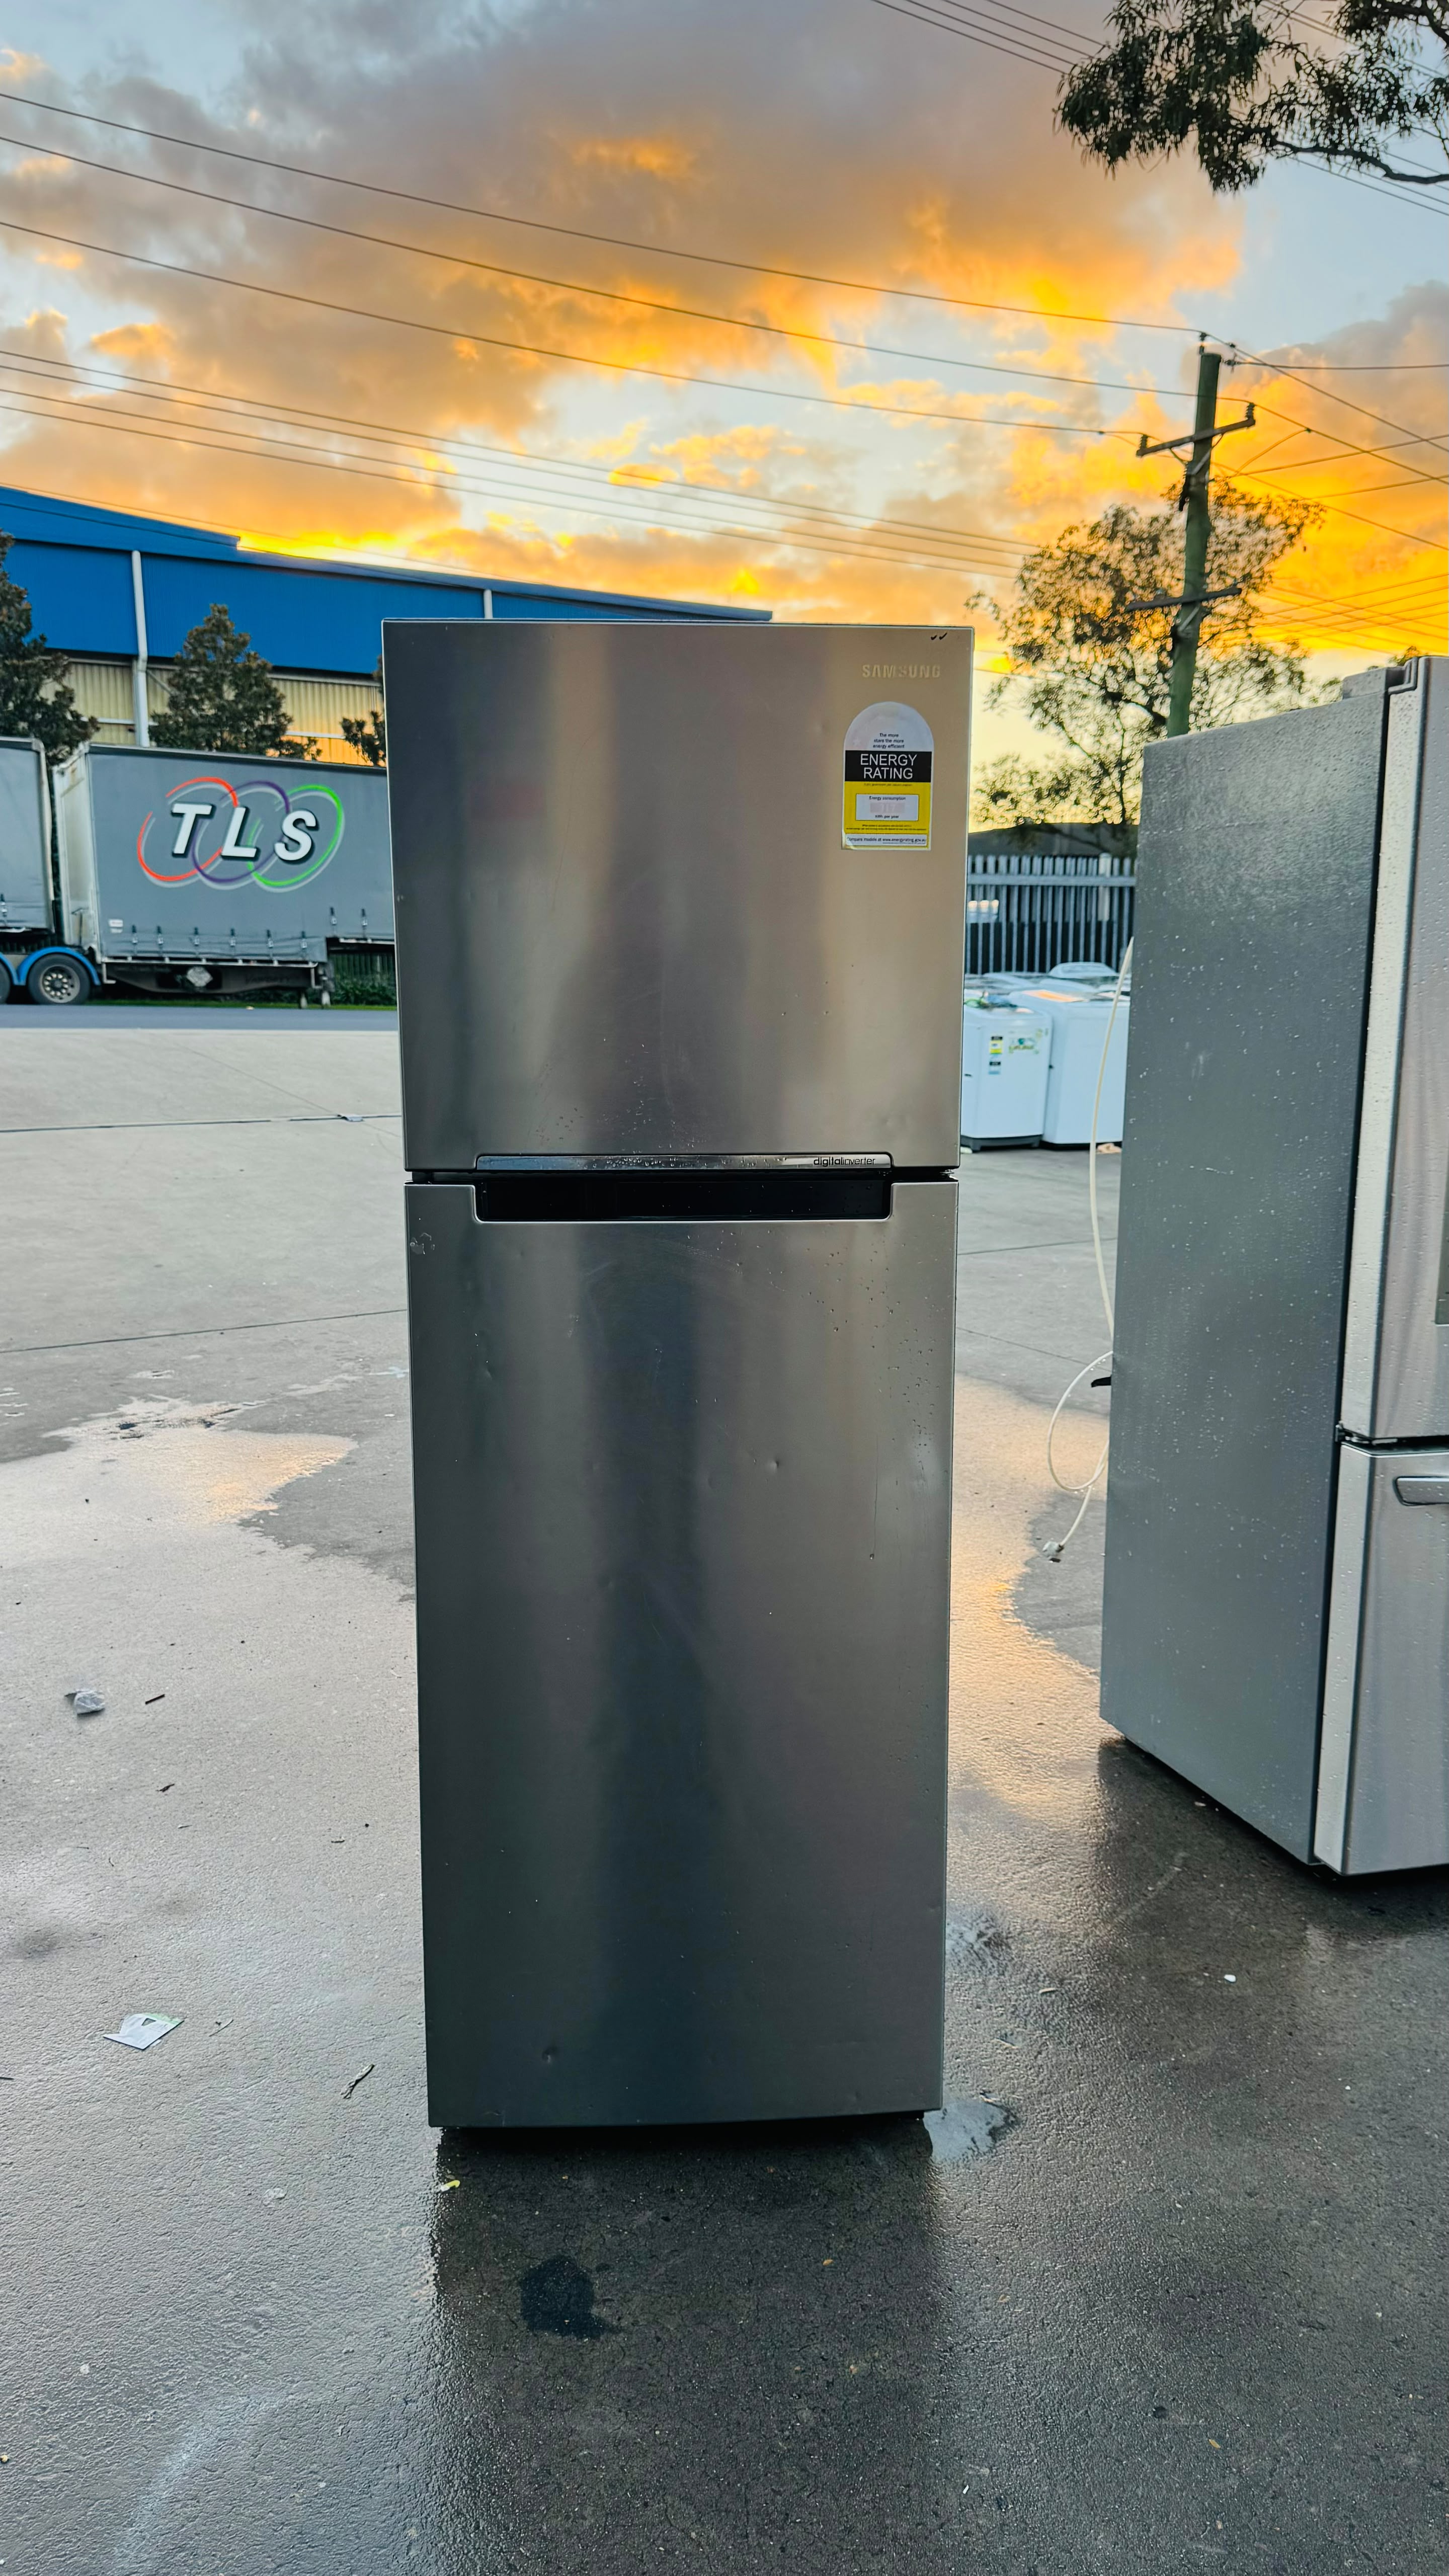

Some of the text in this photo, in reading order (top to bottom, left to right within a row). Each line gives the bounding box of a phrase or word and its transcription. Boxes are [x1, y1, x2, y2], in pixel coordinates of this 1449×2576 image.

[862, 664, 941, 678] SAMSUNG
[860, 754, 917, 766] ENERGY
[863, 767, 913, 779] RATING
[172, 803, 317, 862] TLS
